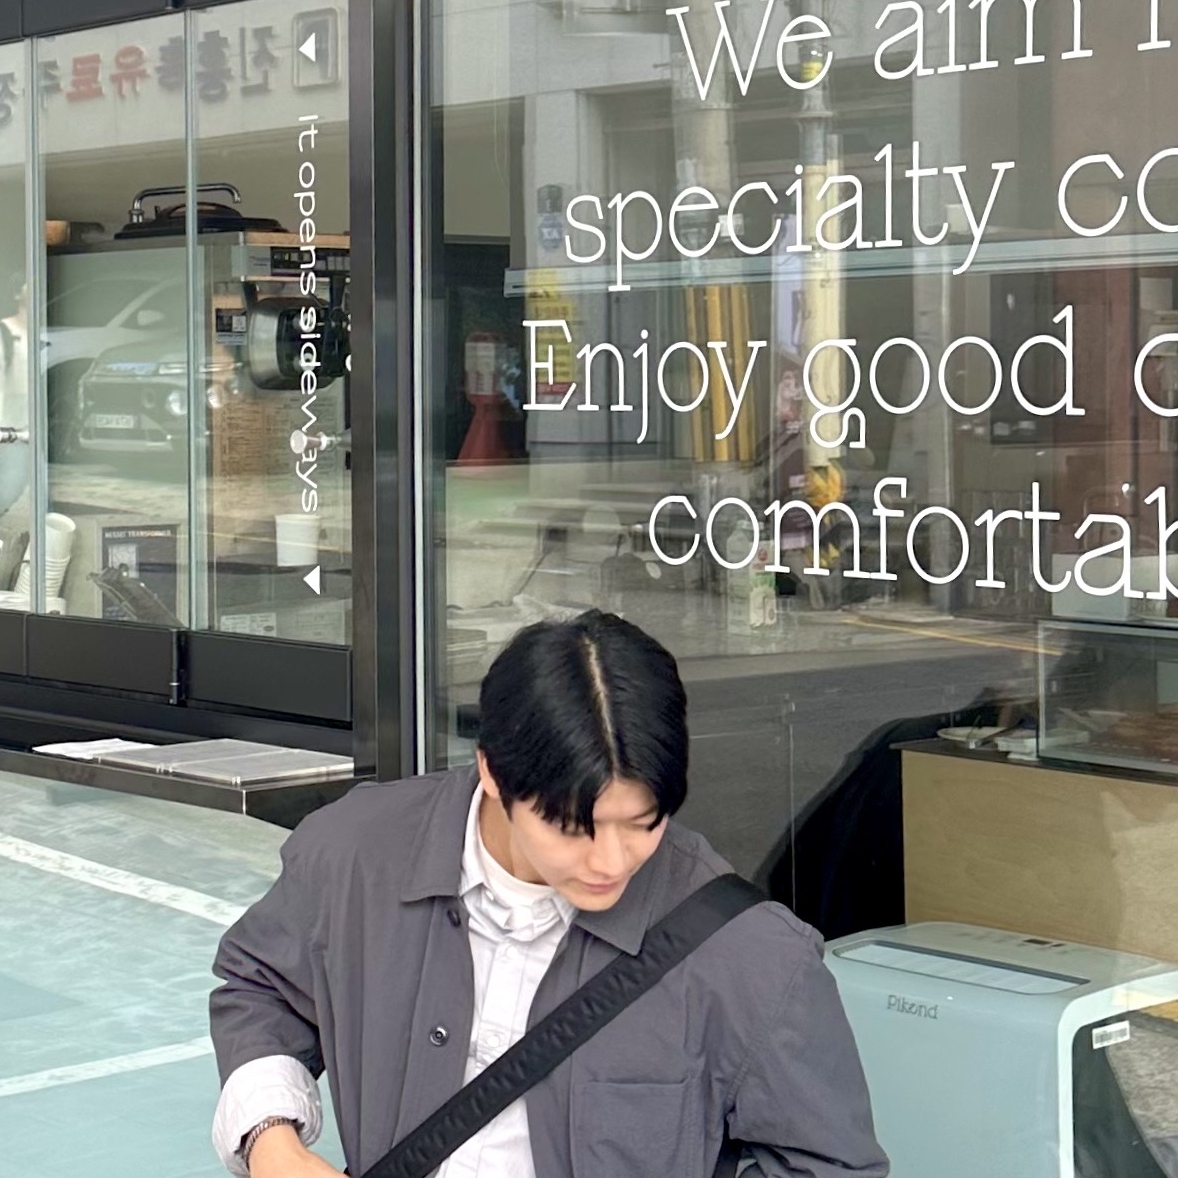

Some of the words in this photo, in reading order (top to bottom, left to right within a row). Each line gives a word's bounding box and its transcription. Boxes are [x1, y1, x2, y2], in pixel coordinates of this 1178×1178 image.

[665, 0, 833, 101] We
[874, 0, 1093, 79] aim
[298, 114, 319, 152] It
[293, 161, 316, 295] opens
[565, 141, 1015, 292] specialty
[522, 320, 767, 444] Enjoy
[803, 305, 1085, 449] good
